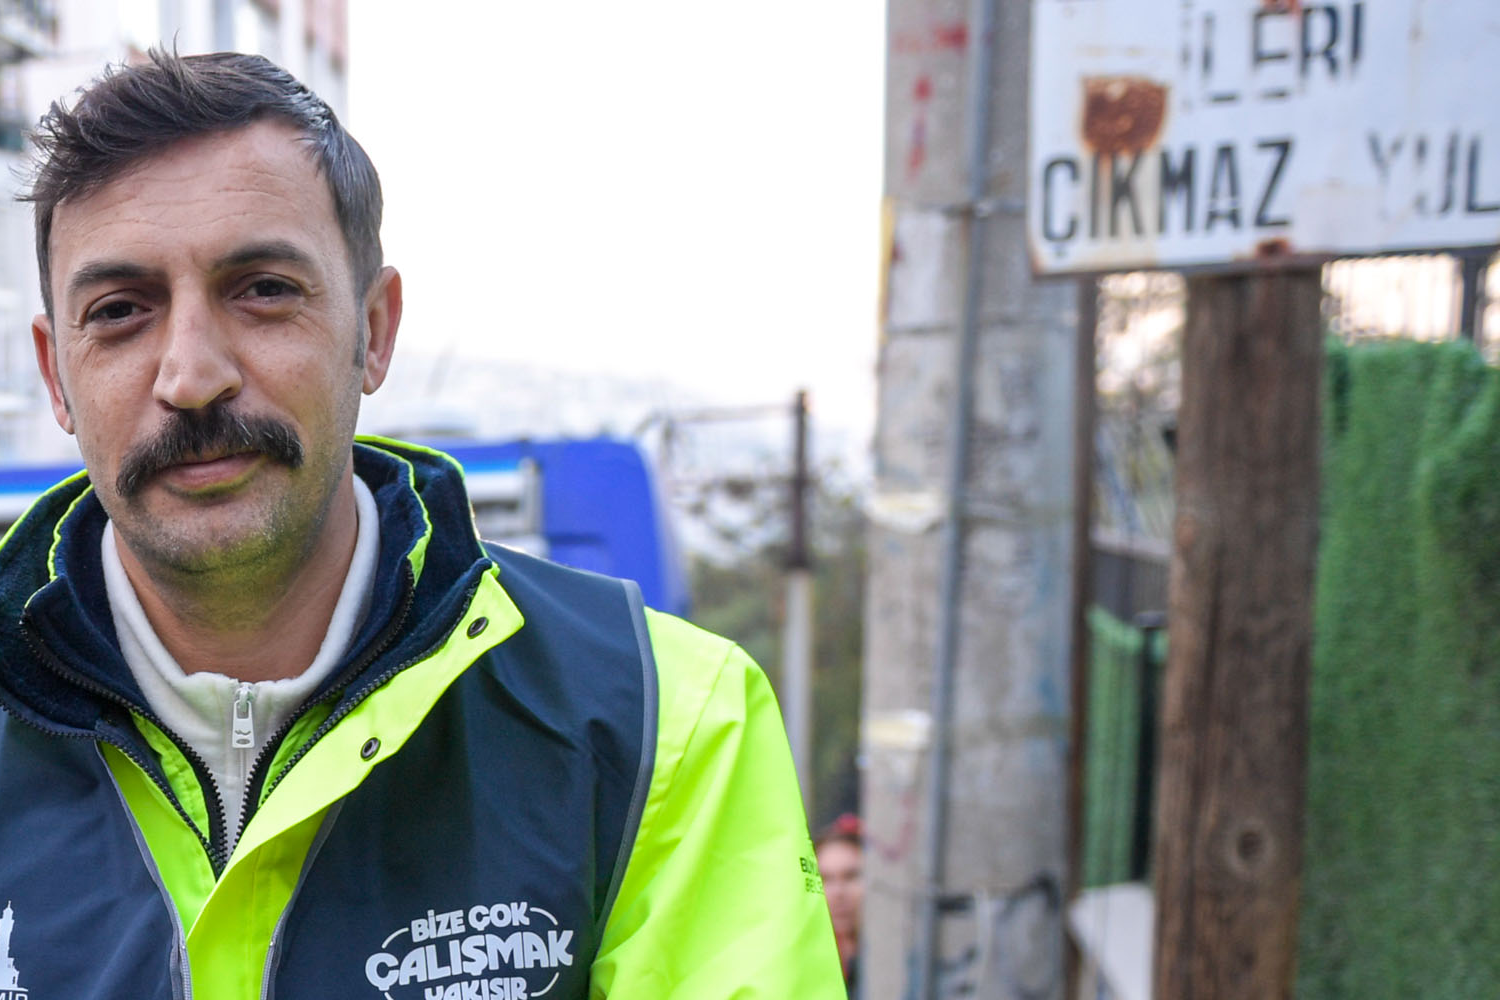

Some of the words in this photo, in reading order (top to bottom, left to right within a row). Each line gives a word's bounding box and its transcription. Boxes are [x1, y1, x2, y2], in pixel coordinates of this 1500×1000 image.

[1042, 136, 1295, 257] ÇIKMAZ
[411, 909, 466, 943] BİZE
[468, 902, 531, 931] ÇOK
[365, 930, 573, 991] ÇALIŞMAK
